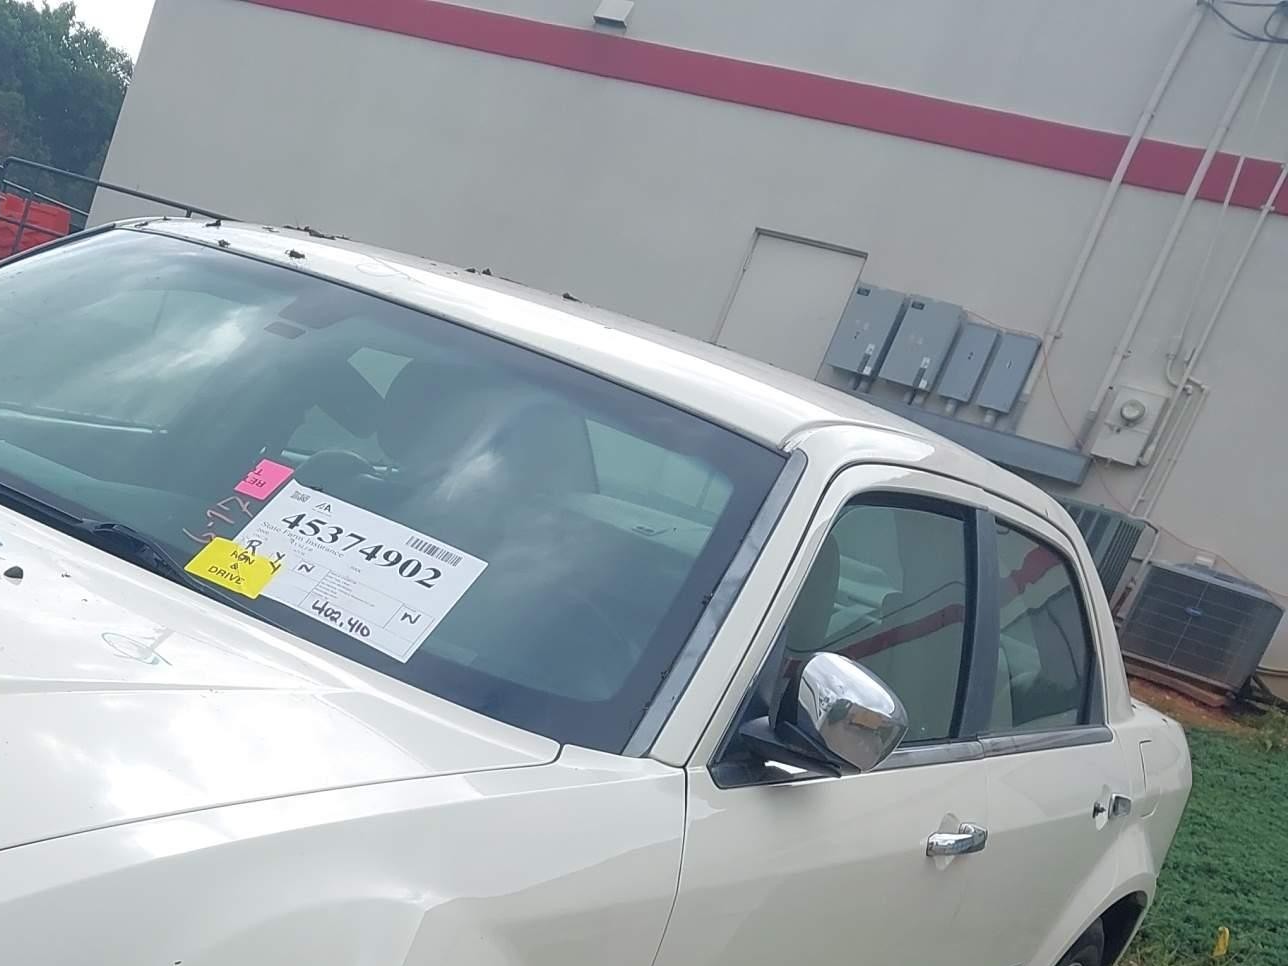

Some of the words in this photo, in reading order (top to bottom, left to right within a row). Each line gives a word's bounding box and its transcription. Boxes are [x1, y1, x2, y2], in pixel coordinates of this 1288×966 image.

[260, 521, 282, 533] State
[282, 529, 305, 543] Farm
[304, 537, 345, 559] Insurance
[281, 509, 444, 589] 45374902
[208, 565, 246, 585] DRIVE
